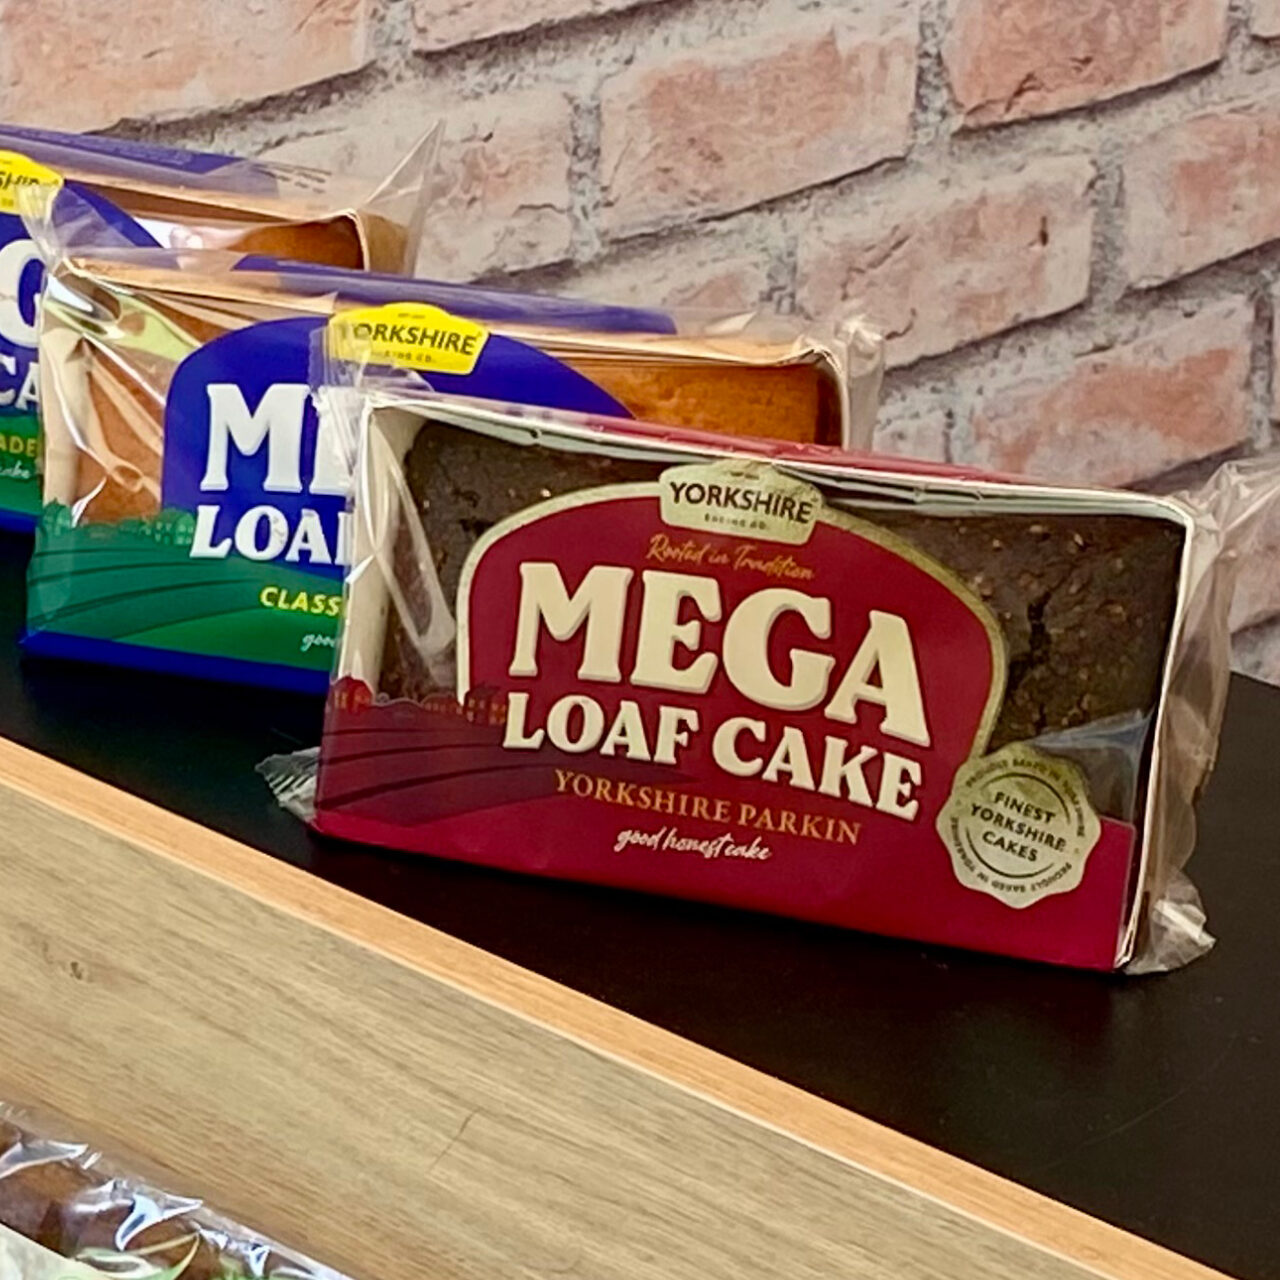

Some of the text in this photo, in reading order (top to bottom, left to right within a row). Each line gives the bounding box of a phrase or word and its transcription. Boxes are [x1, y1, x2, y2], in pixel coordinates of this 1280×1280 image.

[670, 481, 813, 525] YORKSHIRE
[646, 533, 815, 581] Rooted in Tradition
[260, 586, 342, 616] CLASS
[508, 561, 931, 748] MEGA
[502, 691, 922, 822] LOAF CAKE
[554, 768, 864, 846] YORKSHIRE PARKIN
[970, 791, 1067, 863] FINEST YORKSHIRE CAKES
[613, 826, 773, 860] good honest cake
